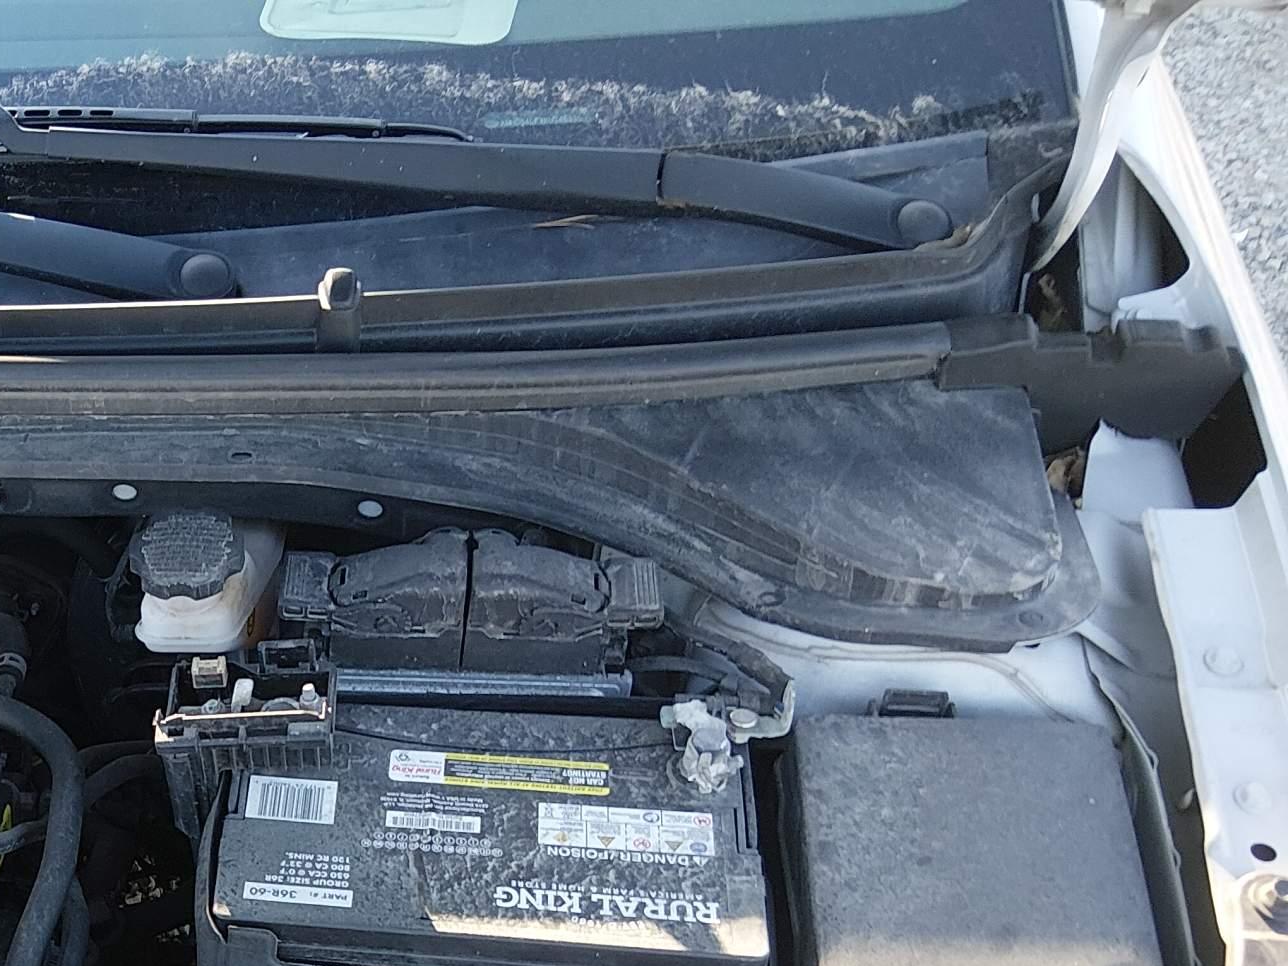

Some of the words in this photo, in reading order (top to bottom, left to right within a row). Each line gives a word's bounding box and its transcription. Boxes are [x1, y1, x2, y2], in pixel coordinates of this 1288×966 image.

[285, 852, 314, 860] MINS.
[316, 854, 329, 862] RC
[314, 862, 328, 870] CA
[264, 874, 284, 883] 36R
[308, 870, 328, 878] CCA
[287, 876, 310, 885] SIZE:
[312, 878, 349, 888] GROUP
[510, 880, 546, 889] STORE
[551, 882, 585, 891] HOME
[603, 886, 634, 895] FARM
[249, 887, 297, 899] 36R-60
[323, 892, 348, 901] PART
[639, 890, 703, 900] AMERICA'S
[493, 886, 582, 914] KING
[590, 893, 720, 924] RURAL
